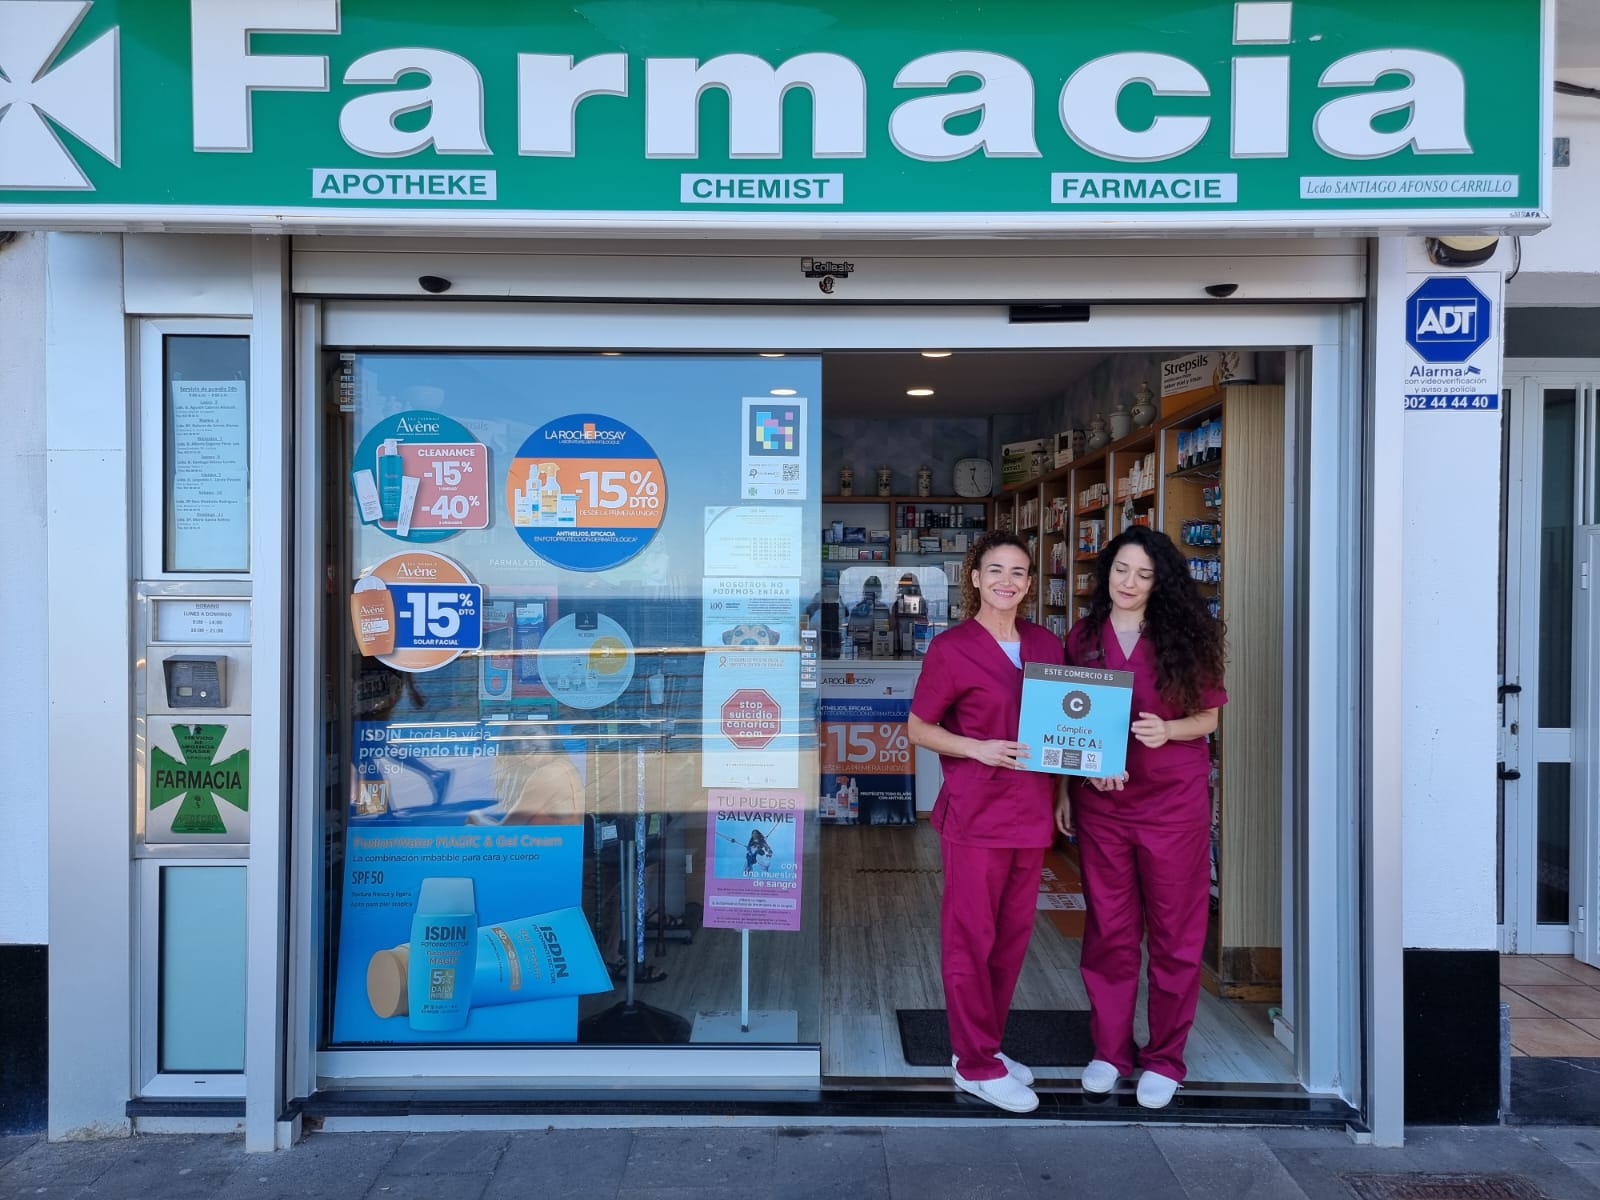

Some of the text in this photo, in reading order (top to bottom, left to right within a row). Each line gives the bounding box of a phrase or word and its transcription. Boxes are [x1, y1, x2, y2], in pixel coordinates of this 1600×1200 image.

[192, 0, 1474, 162] Farmacia
[320, 174, 488, 196] APOTHEKE
[692, 177, 830, 200] CHEMIST
[1061, 178, 1222, 200] FARMACIE
[1307, 179, 1512, 194] Lcdo SANTIAGO AFONSO CARRILLO
[1417, 306, 1477, 335] ADT
[1164, 353, 1208, 377] Strepsils
[1410, 365, 1462, 378] Alarma
[1420, 377, 1487, 385] videoverificación
[1450, 385, 1476, 394] policía
[1430, 396, 1447, 408] 44
[1451, 396, 1468, 408] 44
[1472, 396, 1489, 408] 40
[396, 417, 440, 432] Avène
[545, 430, 626, 440] LA ROCHE POSAY
[417, 448, 476, 457] CLEANANCE
[424, 461, 473, 486] -15%
[576, 471, 658, 509] -15%
[421, 495, 480, 520] -40%
[629, 496, 659, 509] DTO
[396, 562, 437, 577] Avène
[399, 592, 474, 638] -15%
[459, 608, 475, 616] DTO
[1044, 667, 1114, 681] ESTE COMERCIO ES
[739, 700, 763, 710] stop
[1069, 697, 1084, 712] C
[729, 709, 773, 720] suicidio
[726, 720, 776, 729] canarias
[1056, 723, 1093, 735] Cómplice
[361, 728, 492, 742] ISDIN toda la vida
[1043, 734, 1097, 748] MUECA
[359, 743, 500, 759] protegiendo tu piel
[880, 750, 910, 763] DTO
[358, 761, 404, 775] del sol
[156, 770, 242, 790] FARMACIA
[739, 796, 796, 809] PUEDES
[717, 810, 794, 824] SALVARME
[436, 835, 480, 848] MAGIC
[483, 836, 493, 847] &
[496, 835, 517, 847] Gel
[520, 836, 563, 847] Cream
[364, 853, 419, 862] combinación
[461, 854, 480, 863] para
[510, 853, 540, 863] cuerpo
[351, 871, 384, 885] SPF 50
[743, 870, 797, 880] una muestra
[766, 881, 797, 890] sangre
[425, 926, 467, 941] ISDIN
[540, 926, 570, 978] ISDIN
